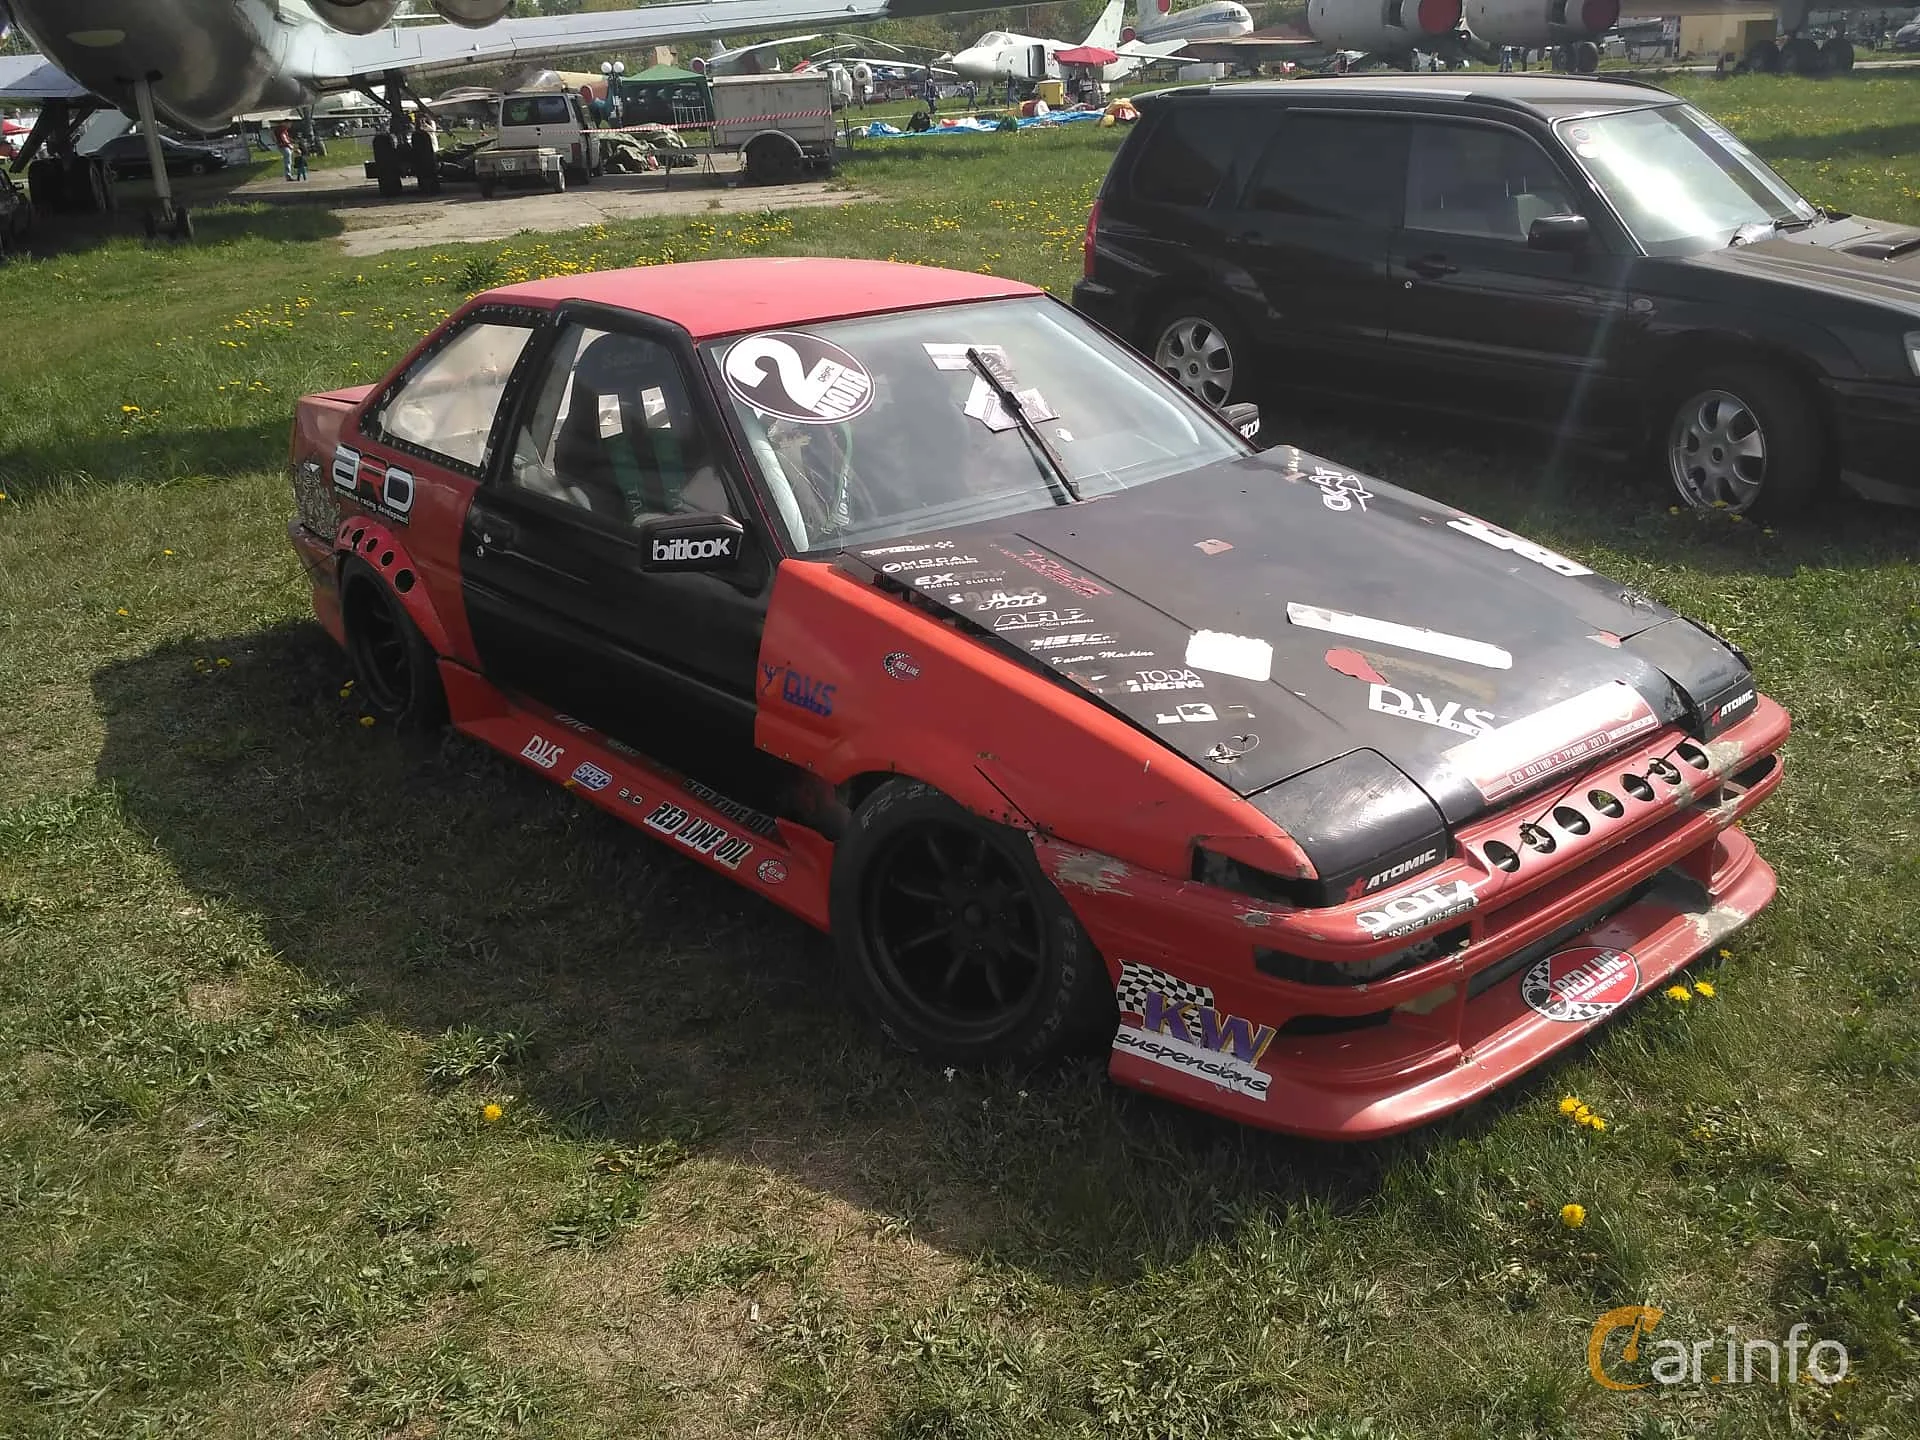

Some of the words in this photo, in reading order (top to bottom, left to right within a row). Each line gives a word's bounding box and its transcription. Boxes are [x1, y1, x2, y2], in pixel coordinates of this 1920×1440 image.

[1136, 669, 1200, 683] TODA
[1142, 679, 1205, 692] RACING
[1720, 689, 1754, 717] ATOMIC
[520, 735, 565, 769] DVS
[644, 801, 689, 834] RED
[675, 817, 728, 854] LINE
[714, 837, 753, 870] OIL
[1367, 848, 1437, 890] ATOMIC
[1553, 968, 1596, 999] RED
[1144, 991, 1278, 1069] KW
[1115, 1033, 1268, 1092] suspensions
